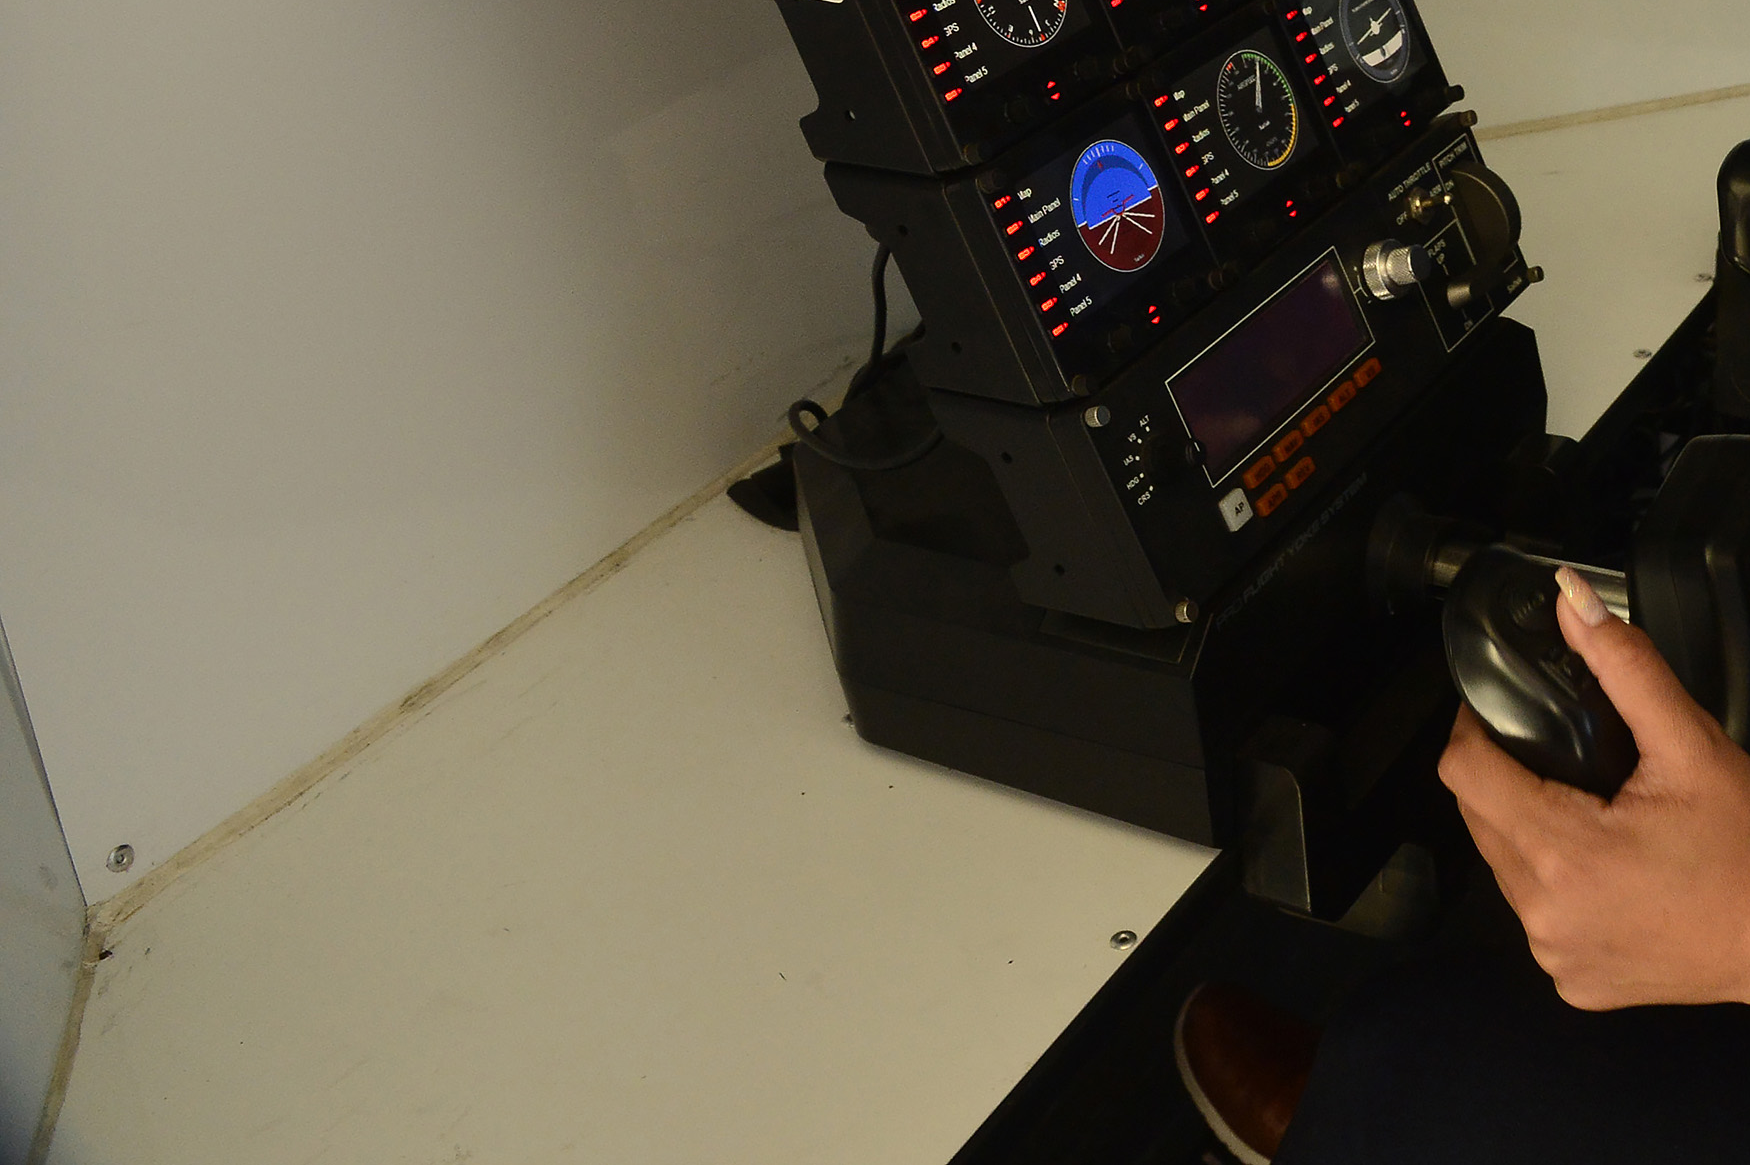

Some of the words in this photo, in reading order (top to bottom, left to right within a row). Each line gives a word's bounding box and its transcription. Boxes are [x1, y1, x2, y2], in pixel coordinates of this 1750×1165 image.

[1388, 185, 1404, 202] AUTO
[1402, 162, 1431, 187] THROTTLE
[1042, 197, 1061, 216] Panel
[1396, 211, 1408, 226] OFF
[1038, 229, 1061, 247] Radios
[1059, 276, 1077, 294] Panel
[1070, 299, 1087, 317] Panel
[1139, 414, 1150, 427] ALT
[1127, 432, 1137, 443] VS
[1123, 455, 1134, 466] IAS
[1126, 476, 1140, 490] HDG
[1137, 490, 1151, 506] CRS
[1234, 502, 1245, 516] AP
[1243, 553, 1285, 603] FLIGHT
